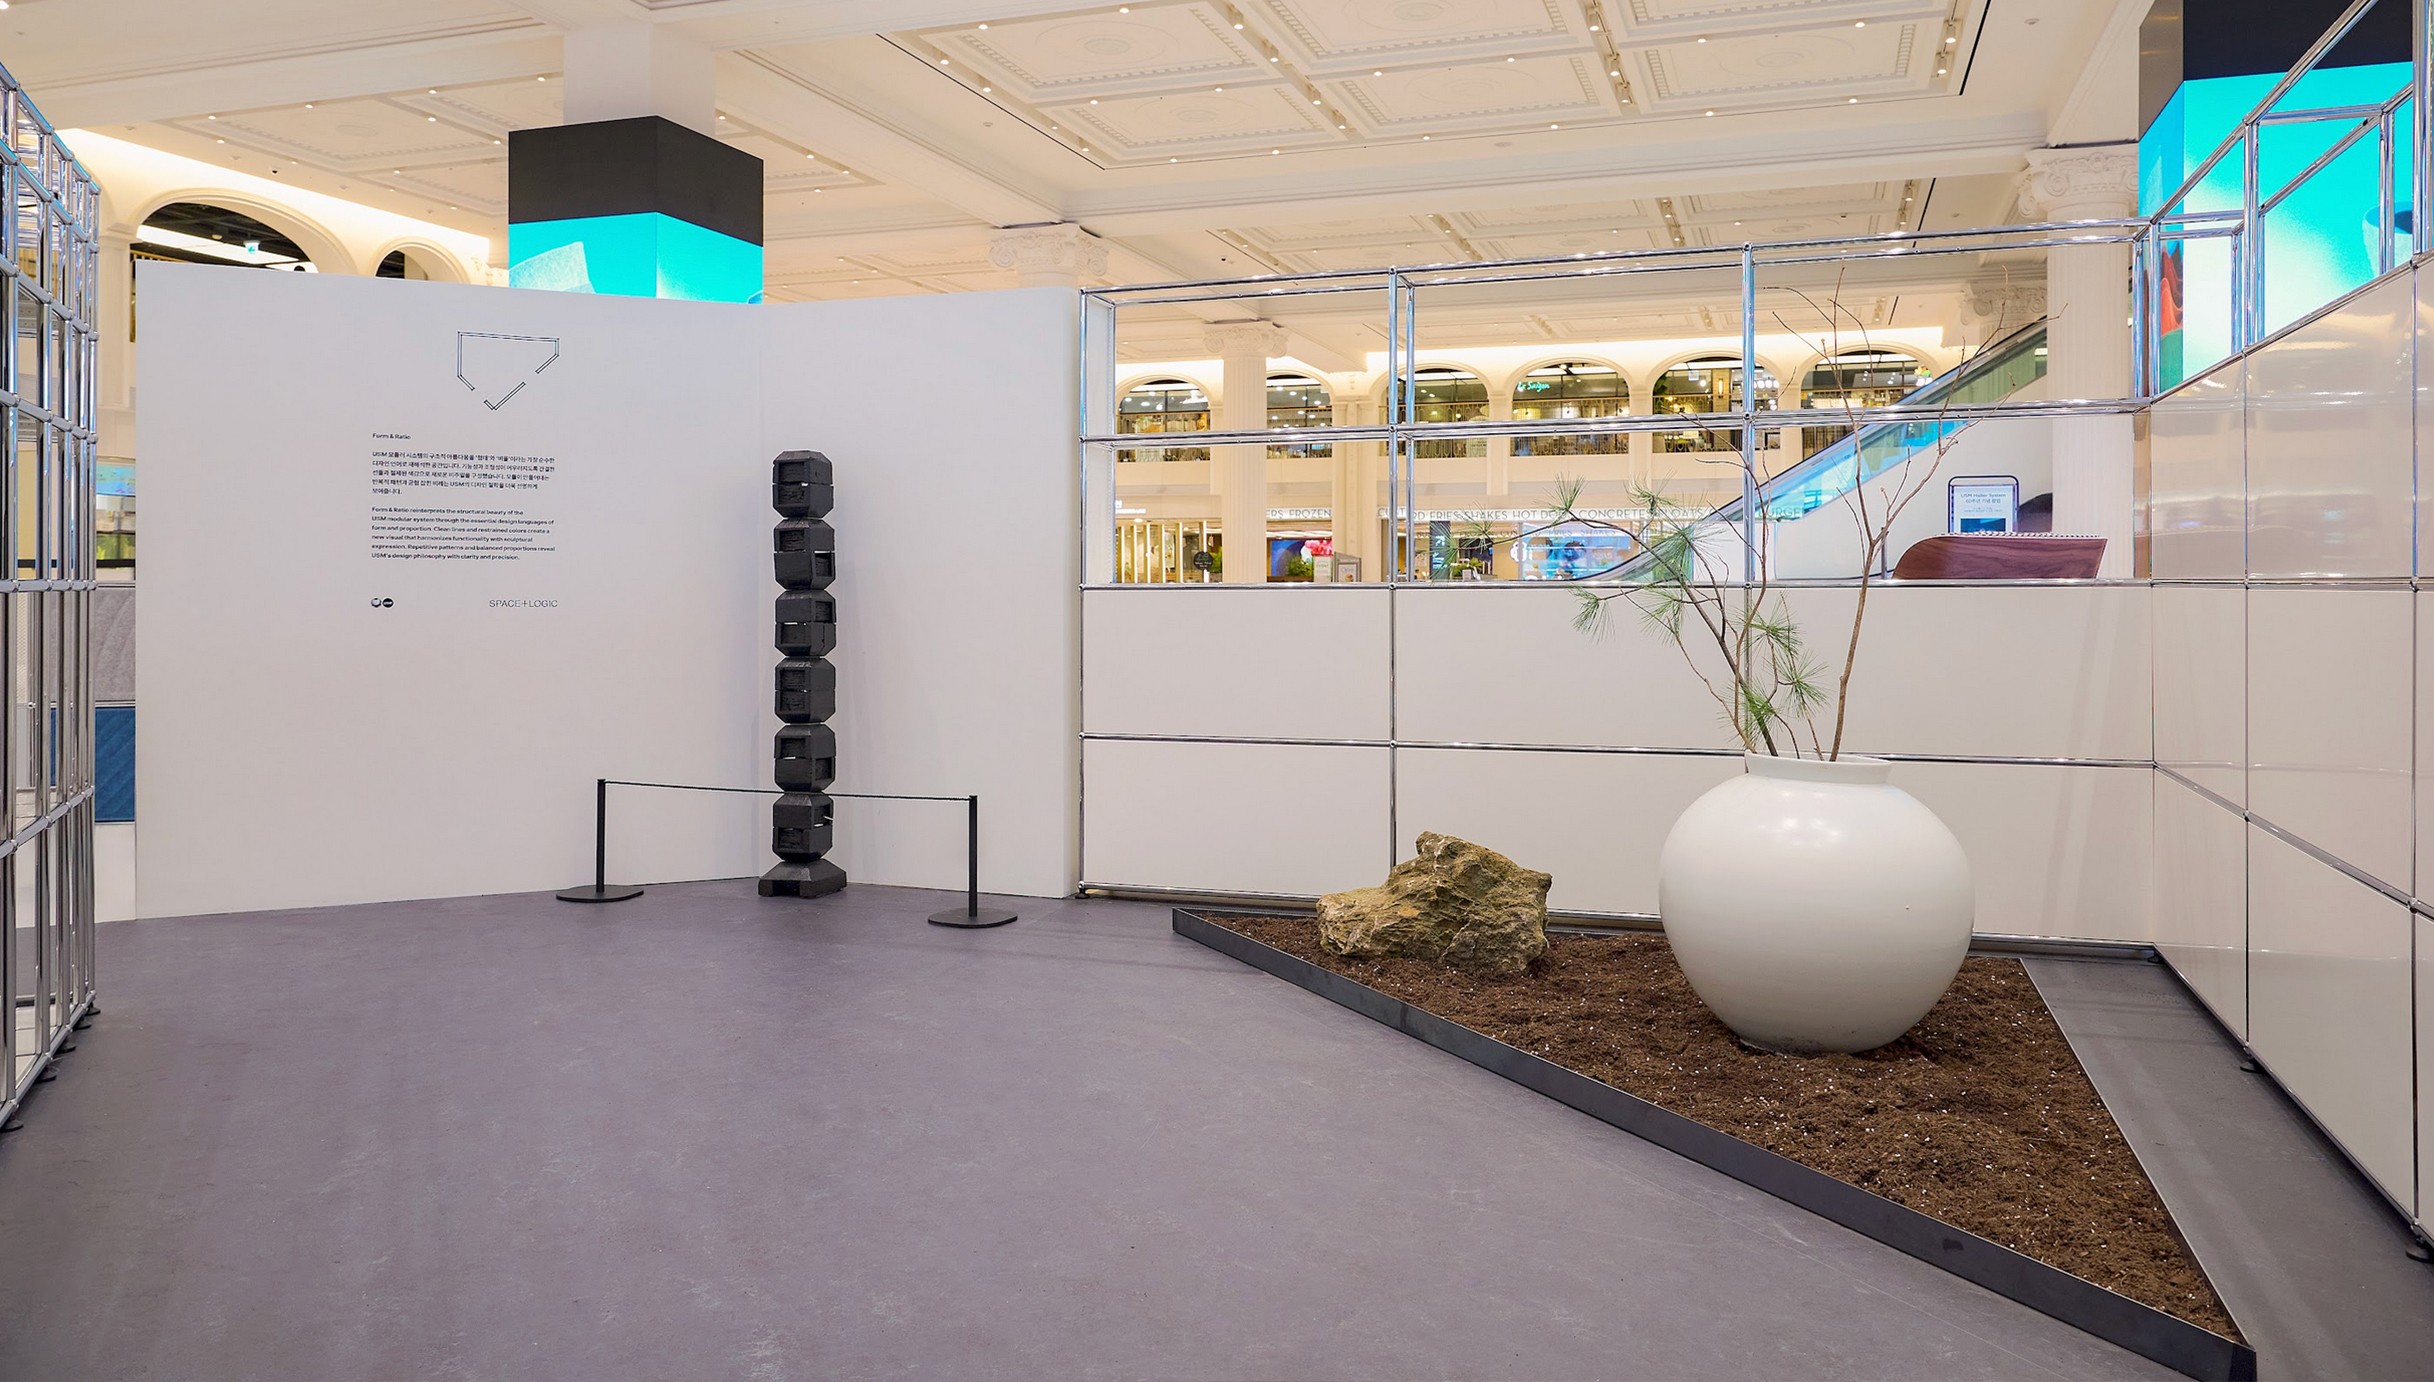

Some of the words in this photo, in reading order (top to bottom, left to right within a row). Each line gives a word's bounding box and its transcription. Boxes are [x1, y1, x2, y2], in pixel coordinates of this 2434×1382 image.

[1289, 508, 1332, 518] FROZEN
[1430, 511, 1458, 520] FRIES
[1464, 511, 1508, 519] SHAKES
[1513, 510, 1537, 520] HOT
